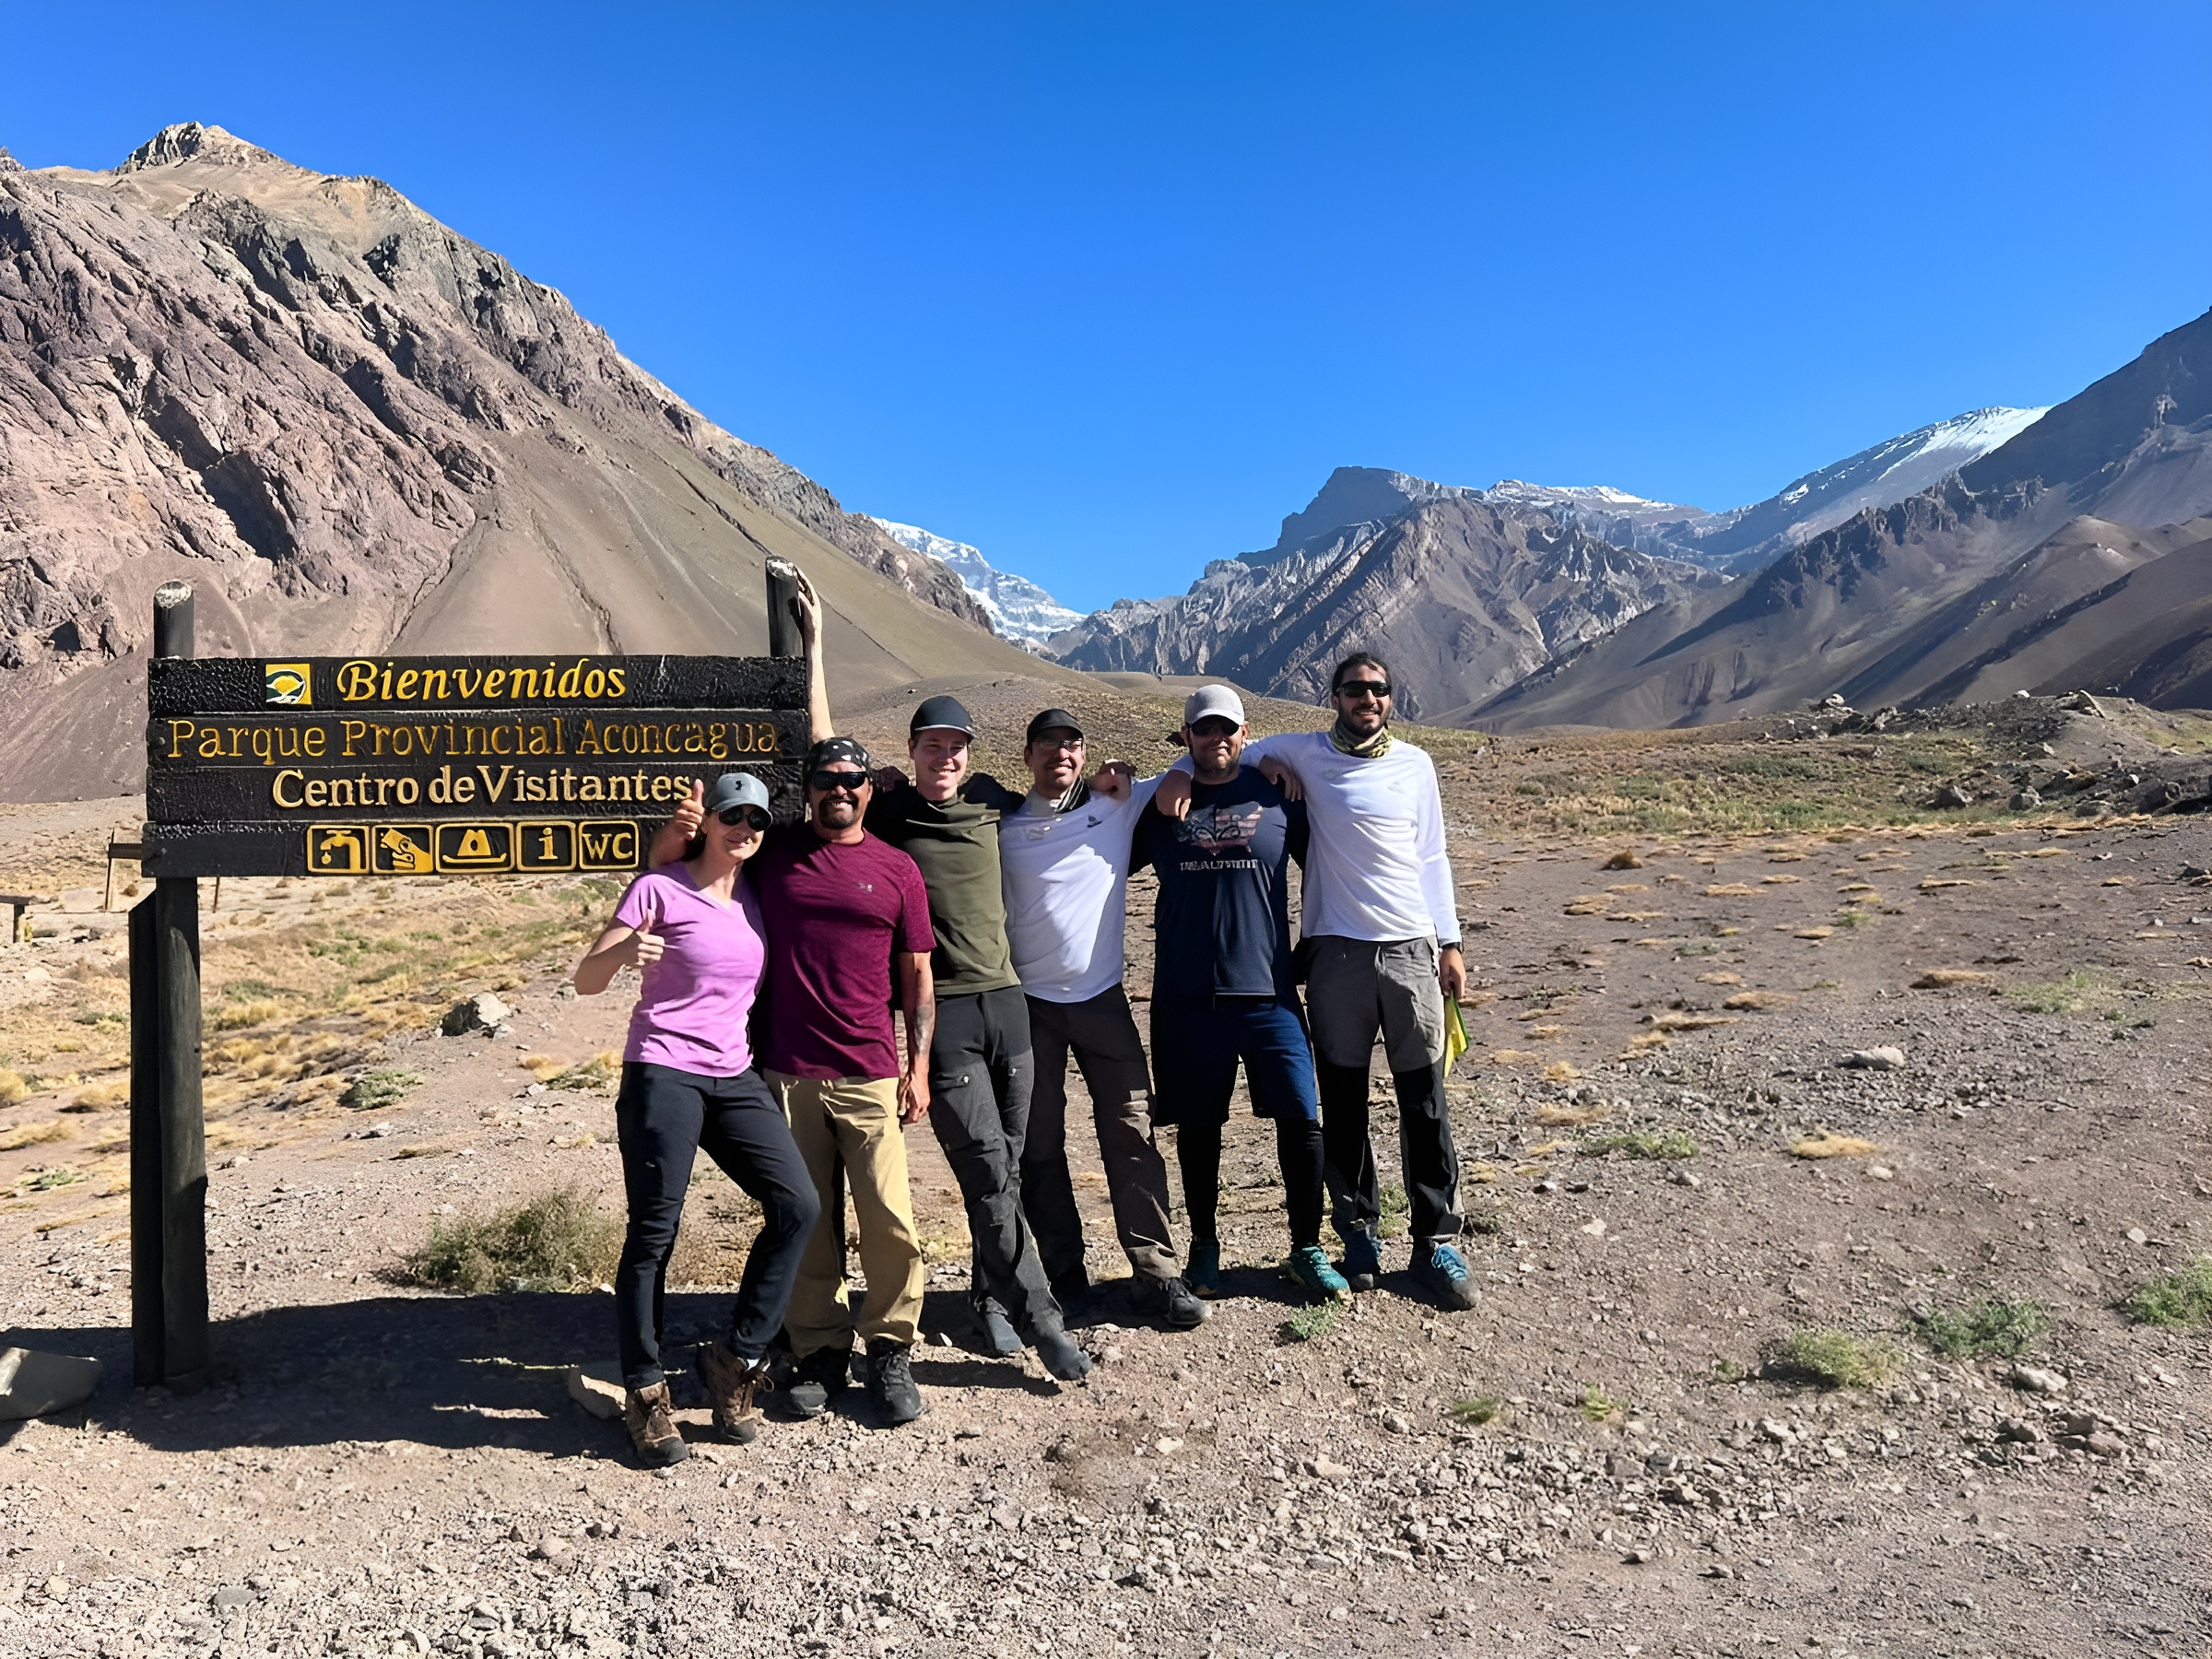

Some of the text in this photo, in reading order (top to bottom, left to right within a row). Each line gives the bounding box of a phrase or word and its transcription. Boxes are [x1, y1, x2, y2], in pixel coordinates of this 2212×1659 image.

[337, 658, 627, 700] Bienvenidos
[167, 717, 782, 765] Parque Provincial Aconcagua
[273, 765, 694, 807] Centro de Visitantes
[583, 831, 634, 860] WC
